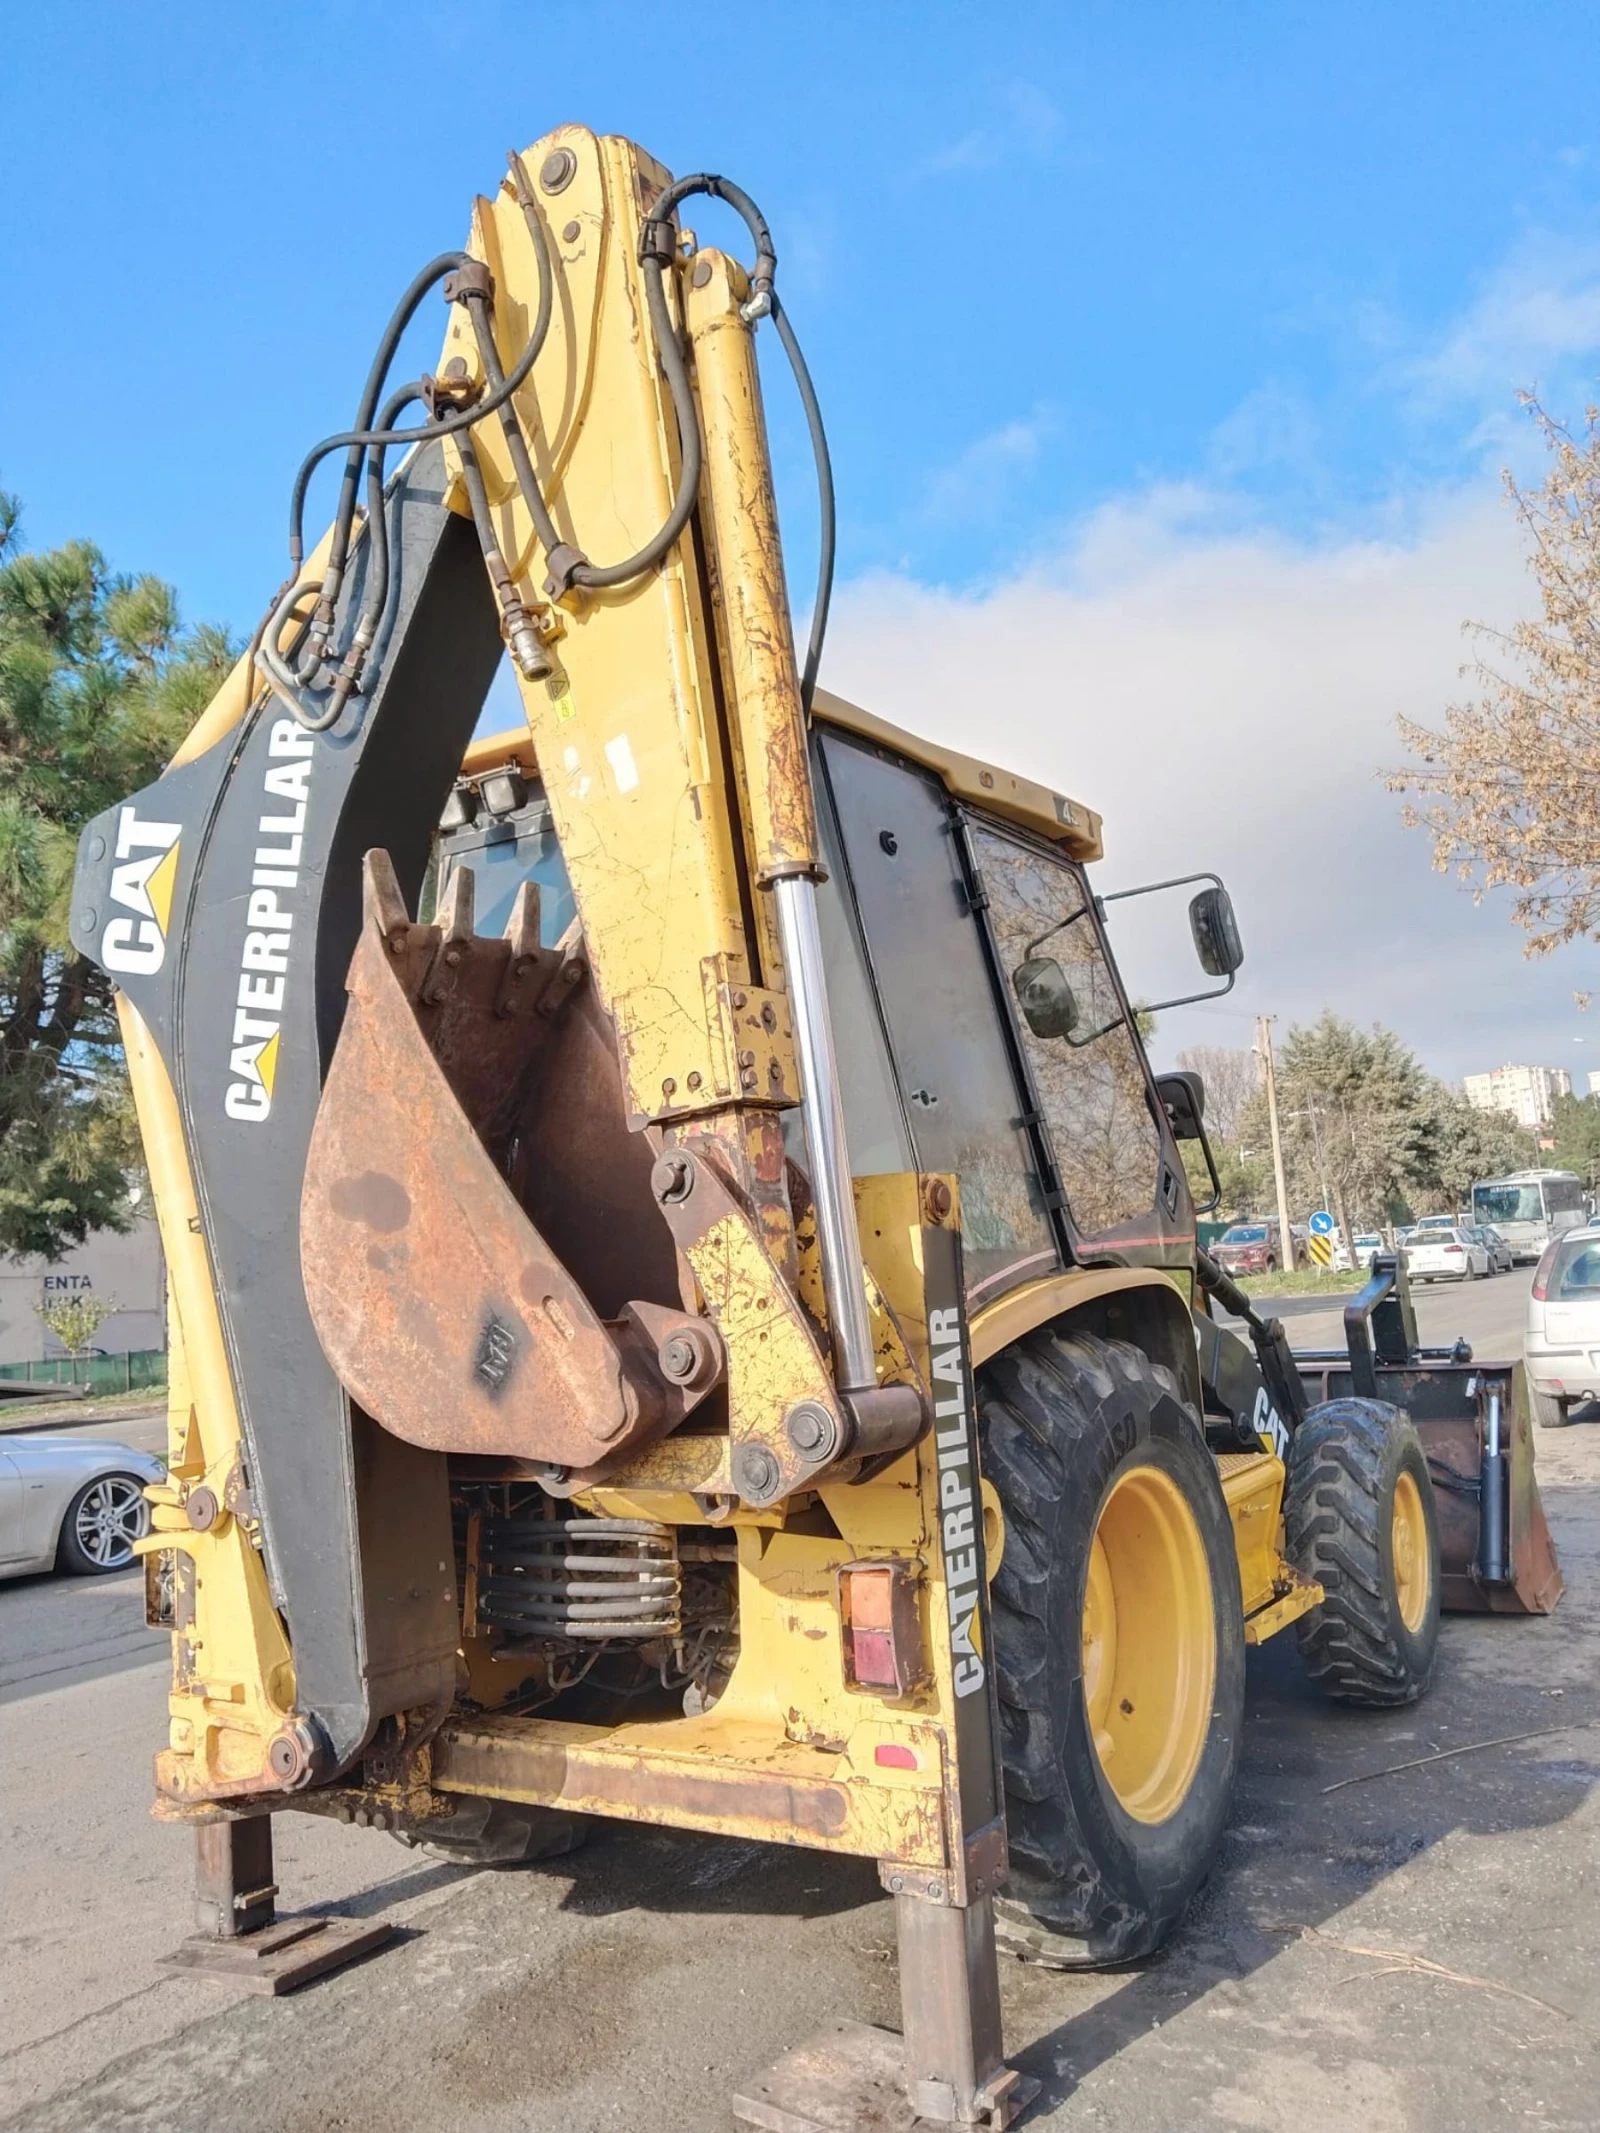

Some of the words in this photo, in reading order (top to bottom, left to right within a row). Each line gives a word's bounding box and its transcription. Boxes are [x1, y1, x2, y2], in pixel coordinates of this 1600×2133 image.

[101, 806, 183, 976] CAT
[225, 719, 314, 1122] CATERPILLAR
[929, 1306, 985, 1699] CATERPILLAR
[1253, 1386, 1290, 1461] CAT
